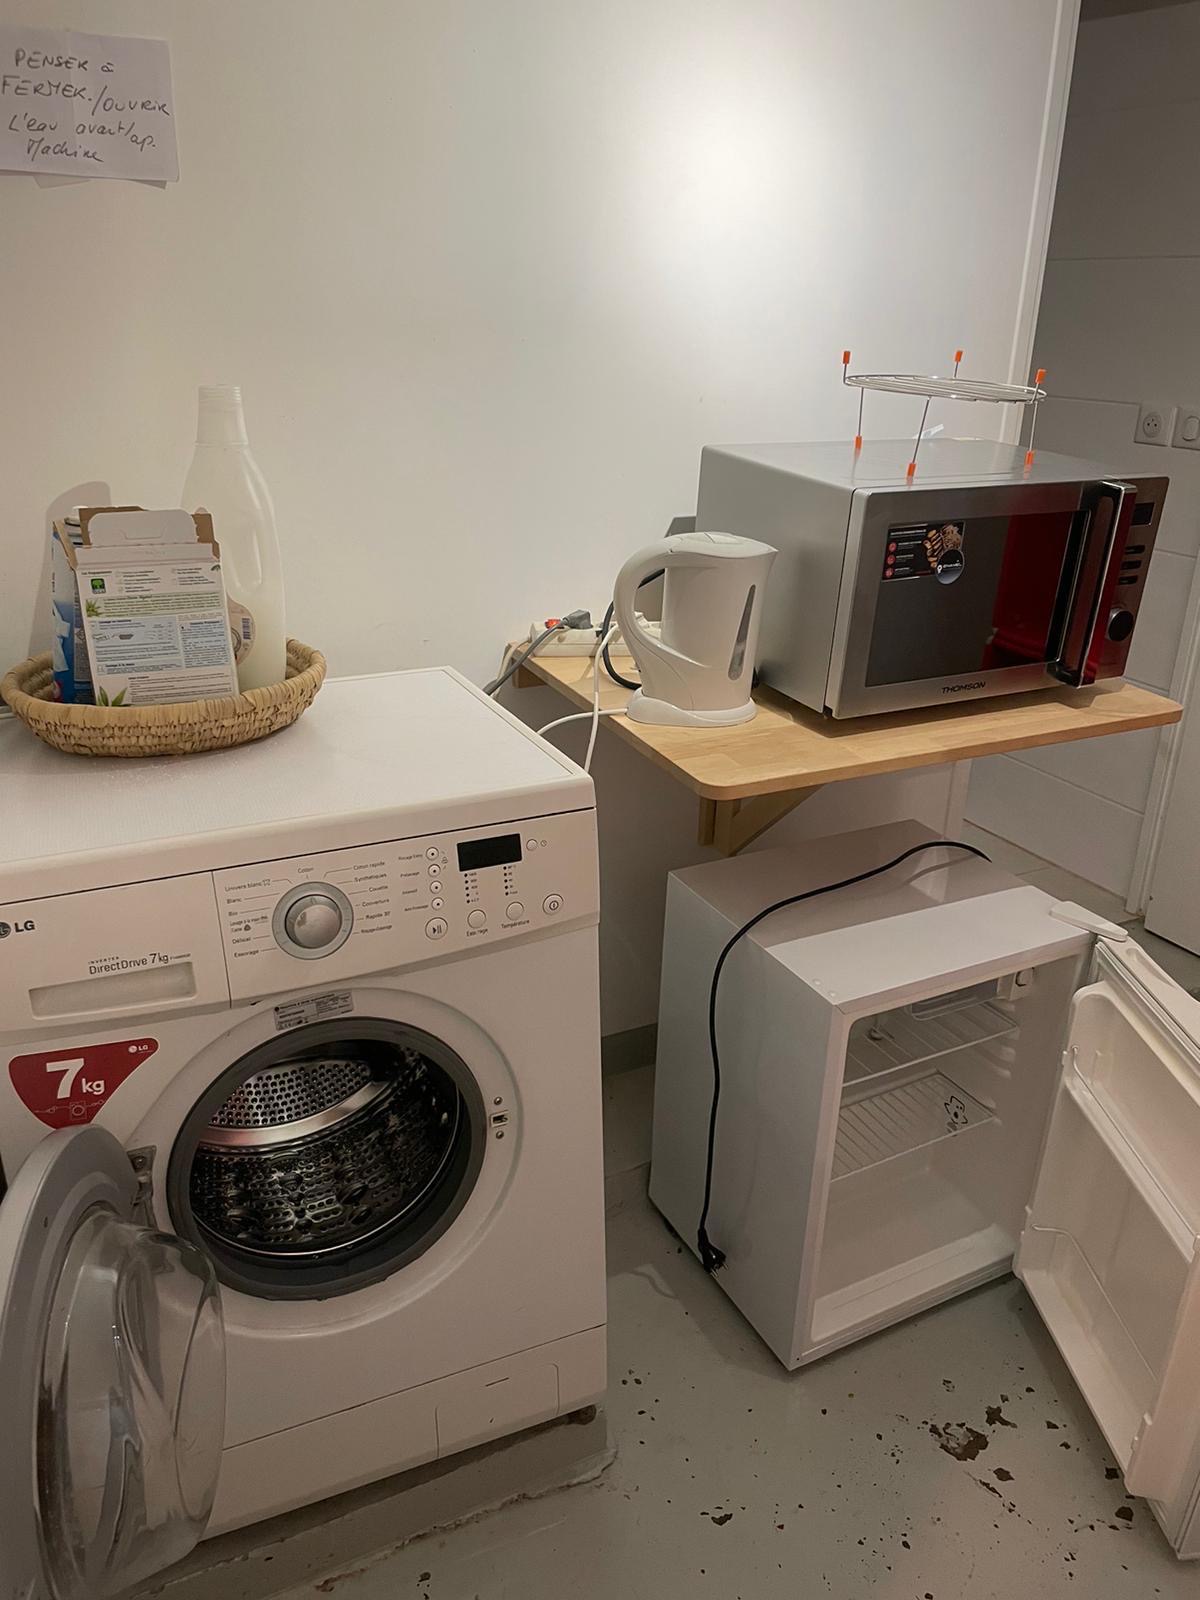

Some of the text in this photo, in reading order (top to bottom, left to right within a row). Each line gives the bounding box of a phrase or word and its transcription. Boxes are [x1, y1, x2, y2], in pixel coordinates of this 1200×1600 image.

[15, 48, 88, 72] PENSER
[941, 681, 986, 694] THOMSON
[14, 920, 36, 933] LG
[138, 1044, 149, 1052] LG
[46, 1057, 105, 1099] 7 kg
